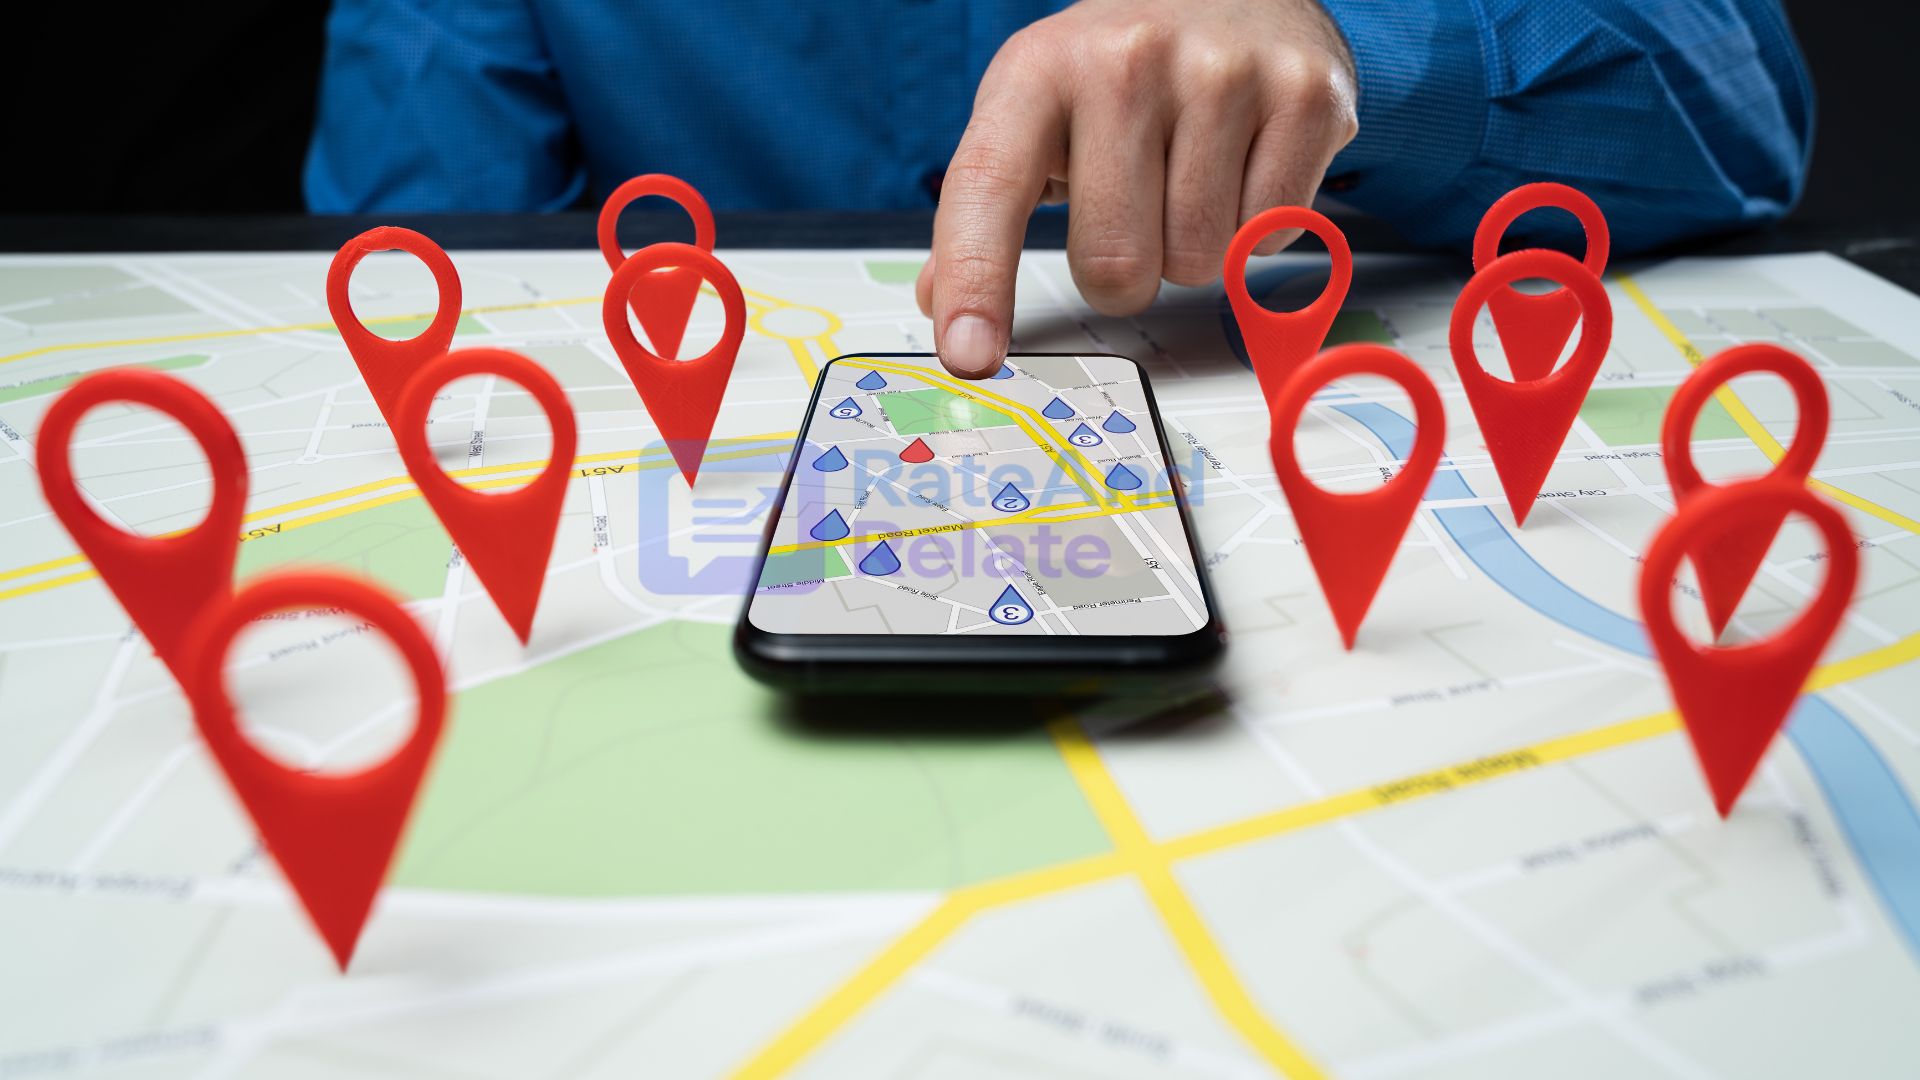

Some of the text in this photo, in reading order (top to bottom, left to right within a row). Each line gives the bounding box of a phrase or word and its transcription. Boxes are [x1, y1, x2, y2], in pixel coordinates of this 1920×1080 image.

[840, 408, 853, 417] 5
[1078, 435, 1091, 444] 3
[1584, 450, 1662, 463] Eagle Road
[581, 463, 626, 478] A51
[1578, 488, 1608, 499] City
[1003, 498, 1018, 509] 2
[877, 523, 964, 540] Market Road
[1143, 556, 1162, 571] A51
[766, 577, 825, 591] Middle Street
[897, 584, 939, 601] Side Road
[1072, 596, 1142, 611] Perimeter Road
[1002, 606, 1020, 620] 3
